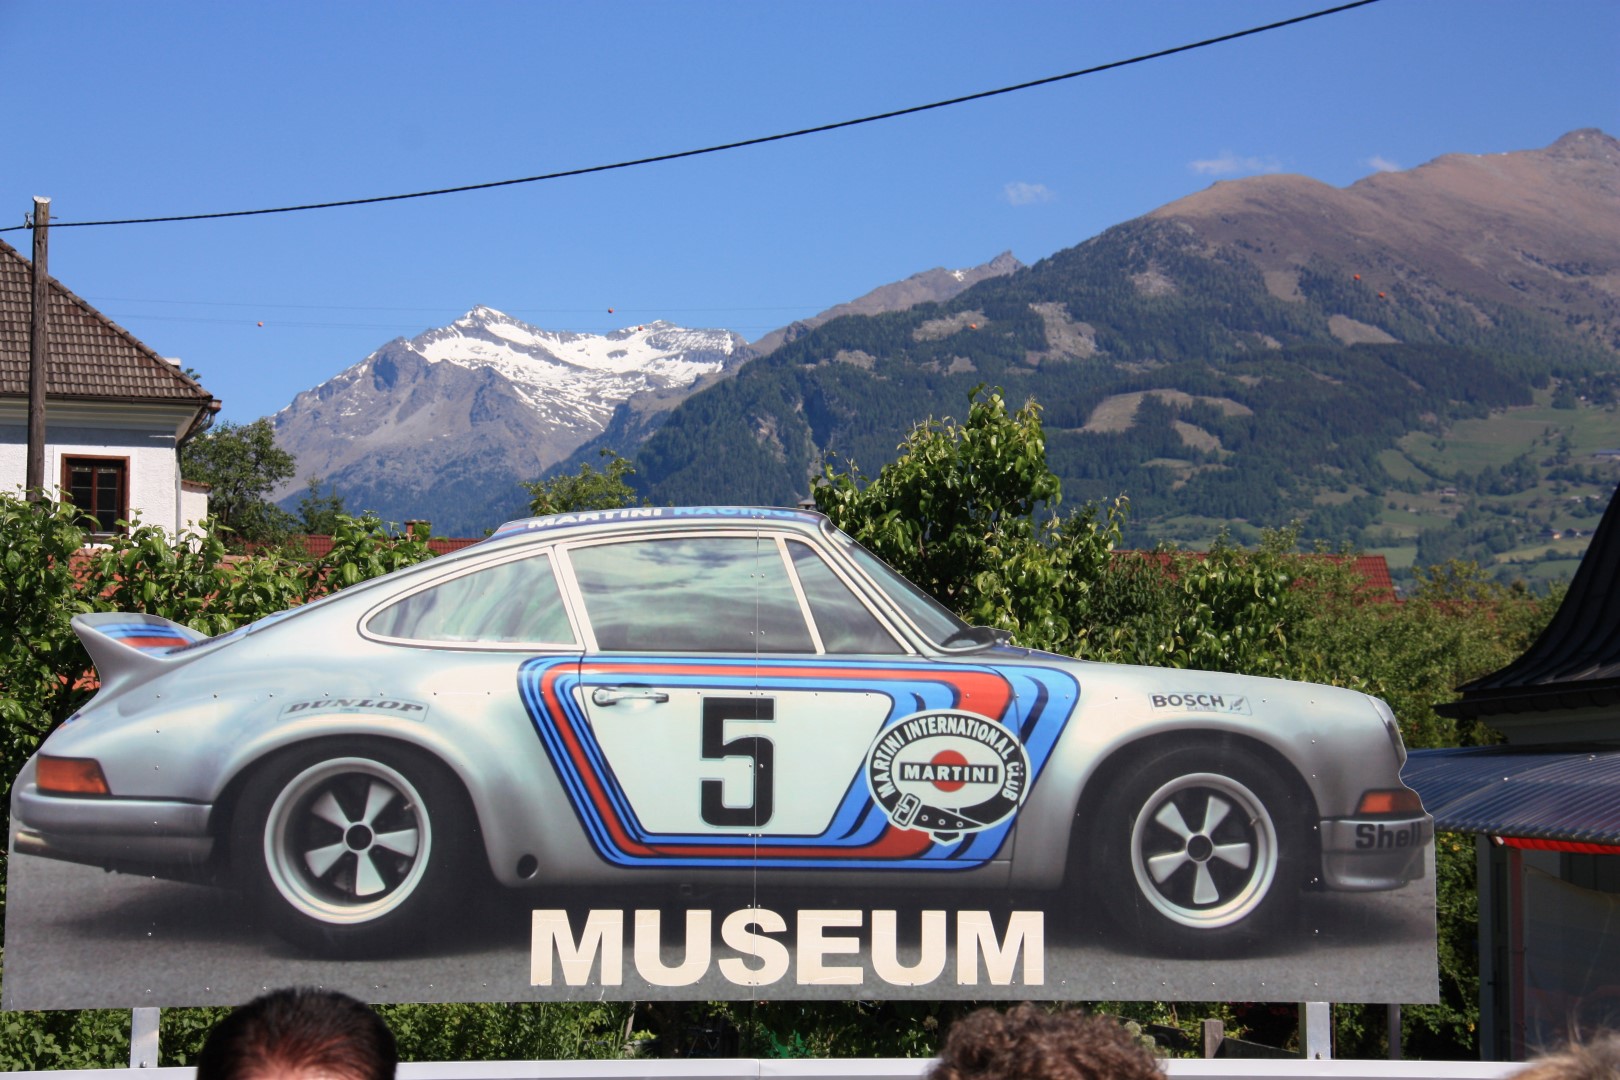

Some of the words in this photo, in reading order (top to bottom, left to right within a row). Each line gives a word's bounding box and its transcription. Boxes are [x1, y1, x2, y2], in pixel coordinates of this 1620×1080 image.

[527, 508, 662, 529] MARTINI
[285, 699, 424, 714] DUNLOP
[1151, 694, 1225, 708] BOSCH
[700, 696, 775, 828] 5
[873, 730, 906, 799] MARTINI
[903, 716, 1013, 761] INTERNATIONAL
[1001, 761, 1024, 801] CLUB
[903, 764, 994, 783] MARTINI
[1355, 822, 1421, 850] Shell
[530, 908, 1045, 987] MUSEUM
